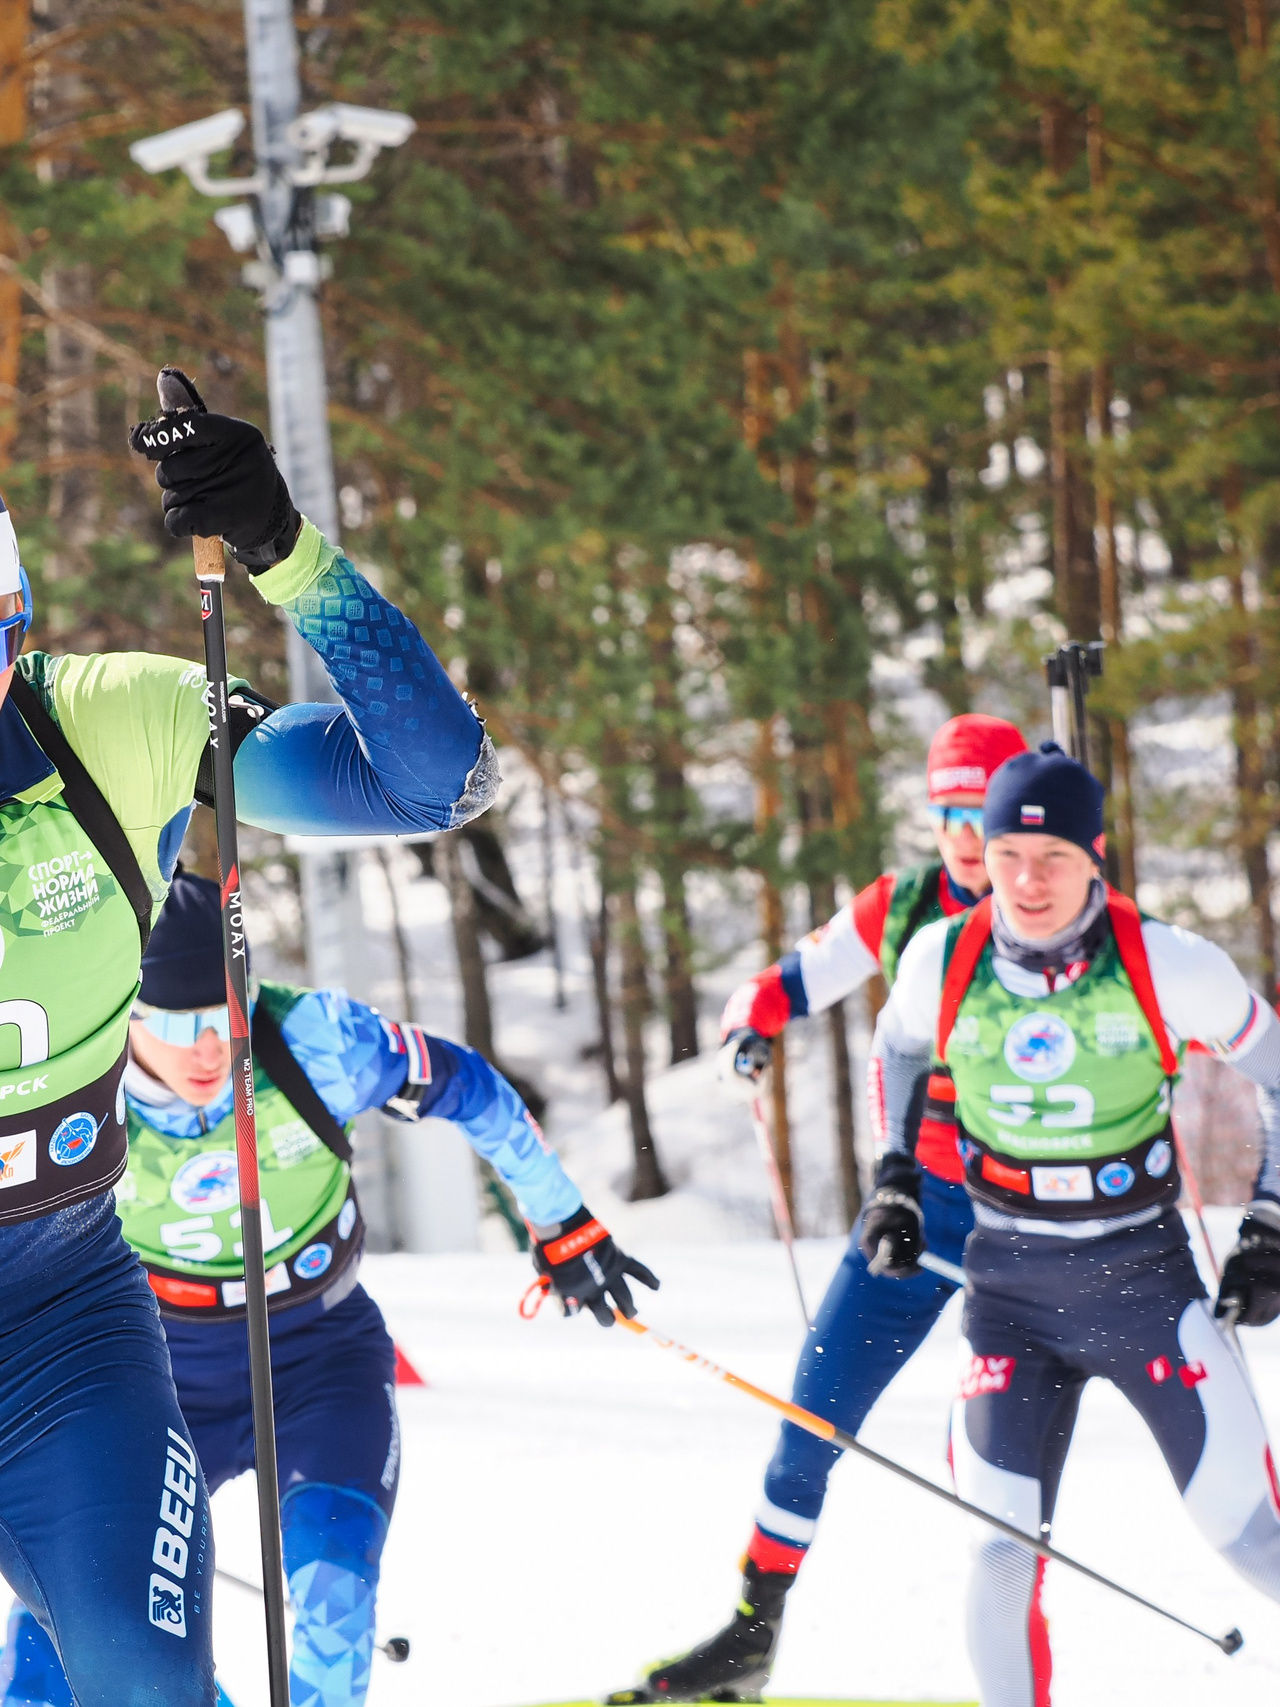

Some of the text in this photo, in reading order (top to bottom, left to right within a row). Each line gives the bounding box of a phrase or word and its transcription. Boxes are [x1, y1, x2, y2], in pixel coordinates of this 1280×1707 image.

[142, 420, 196, 448] MOAX
[28, 851, 80, 882] СПОРТ
[32, 863, 95, 900] НОРМА
[36, 878, 99, 918] ЖИЗНИ
[41, 893, 100, 928] ФЕДЕРАЛЬНЫЙ
[42, 919, 76, 938] ПРОЕКТ
[228, 890, 246, 960] MOAX
[243, 1057, 254, 1116] M2 TEAM PRO
[159, 1198, 294, 1262] 51
[152, 1426, 198, 1580] BEEU
[193, 1590, 201, 1614] BE
